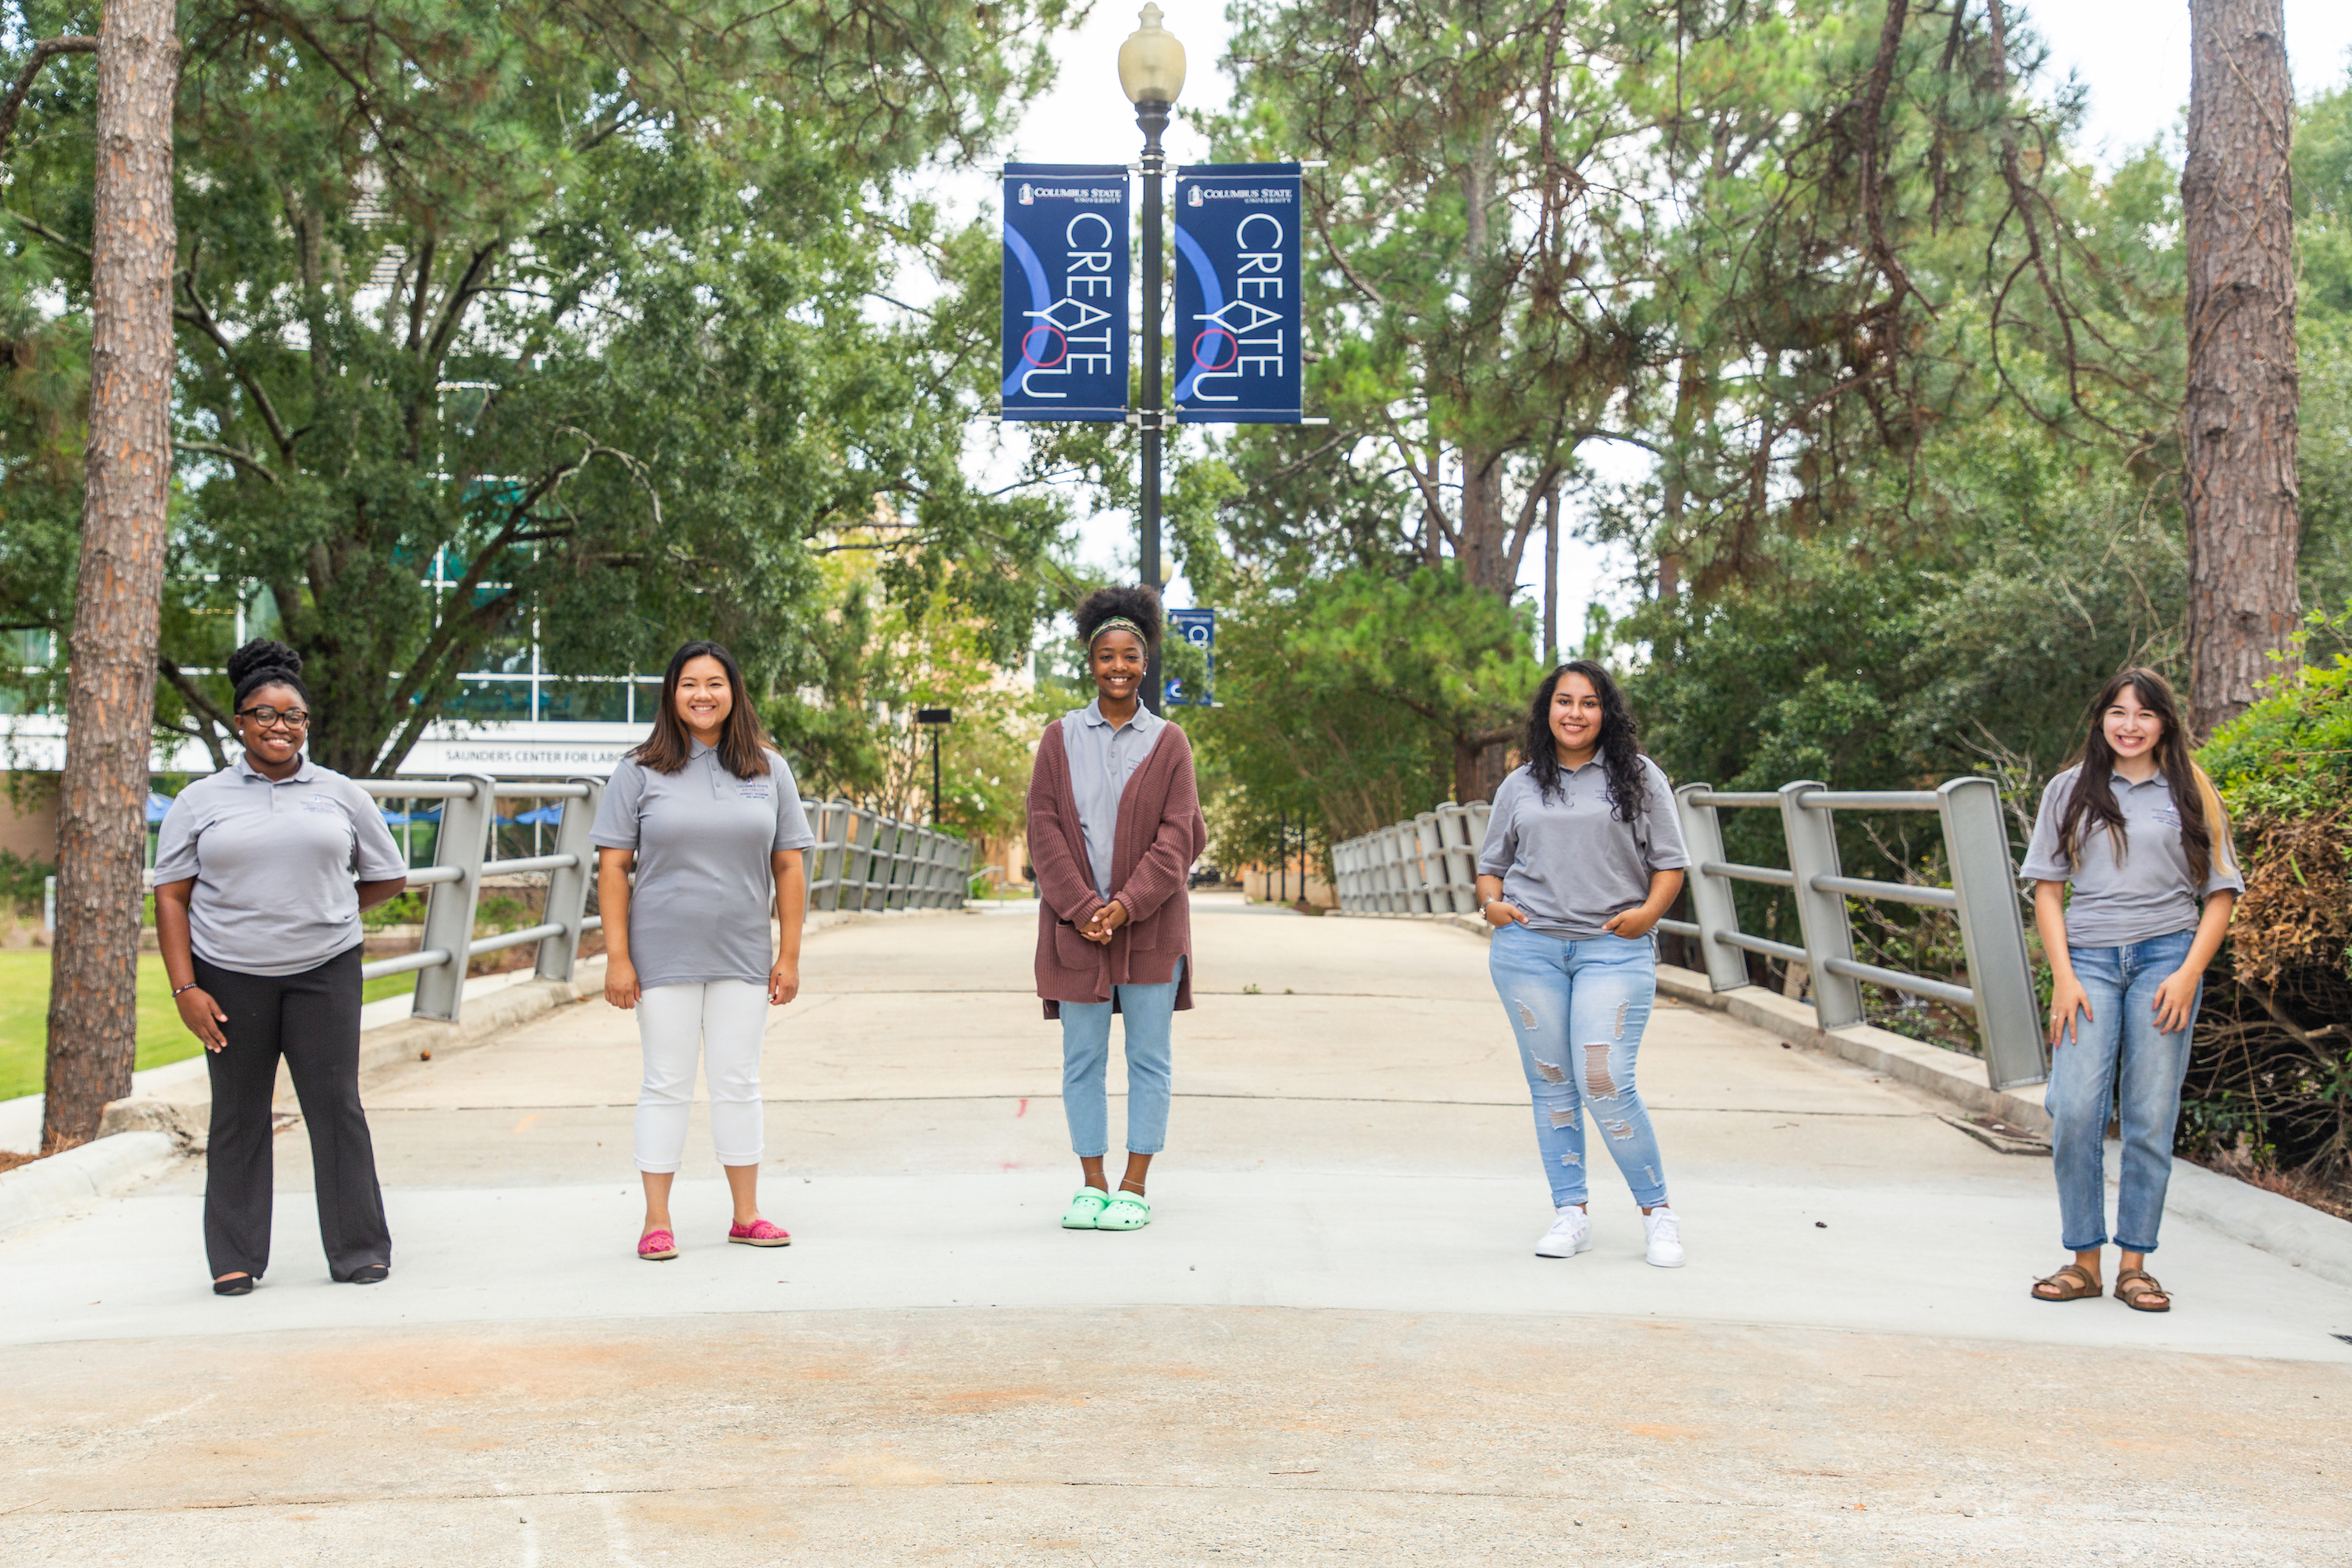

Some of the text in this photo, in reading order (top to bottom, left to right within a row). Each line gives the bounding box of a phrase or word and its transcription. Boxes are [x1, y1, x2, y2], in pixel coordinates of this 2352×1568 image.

[1034, 187, 1122, 198] COLUMBUS STATE
[1204, 188, 1292, 199] COLUMBUS STATE
[1066, 212, 1113, 375] CREATE
[1236, 213, 1284, 377] CREATE
[1022, 298, 1069, 399] YOU
[1192, 300, 1240, 402] YOU
[446, 750, 624, 763] SAUNDERS CENTER FOR LABO
